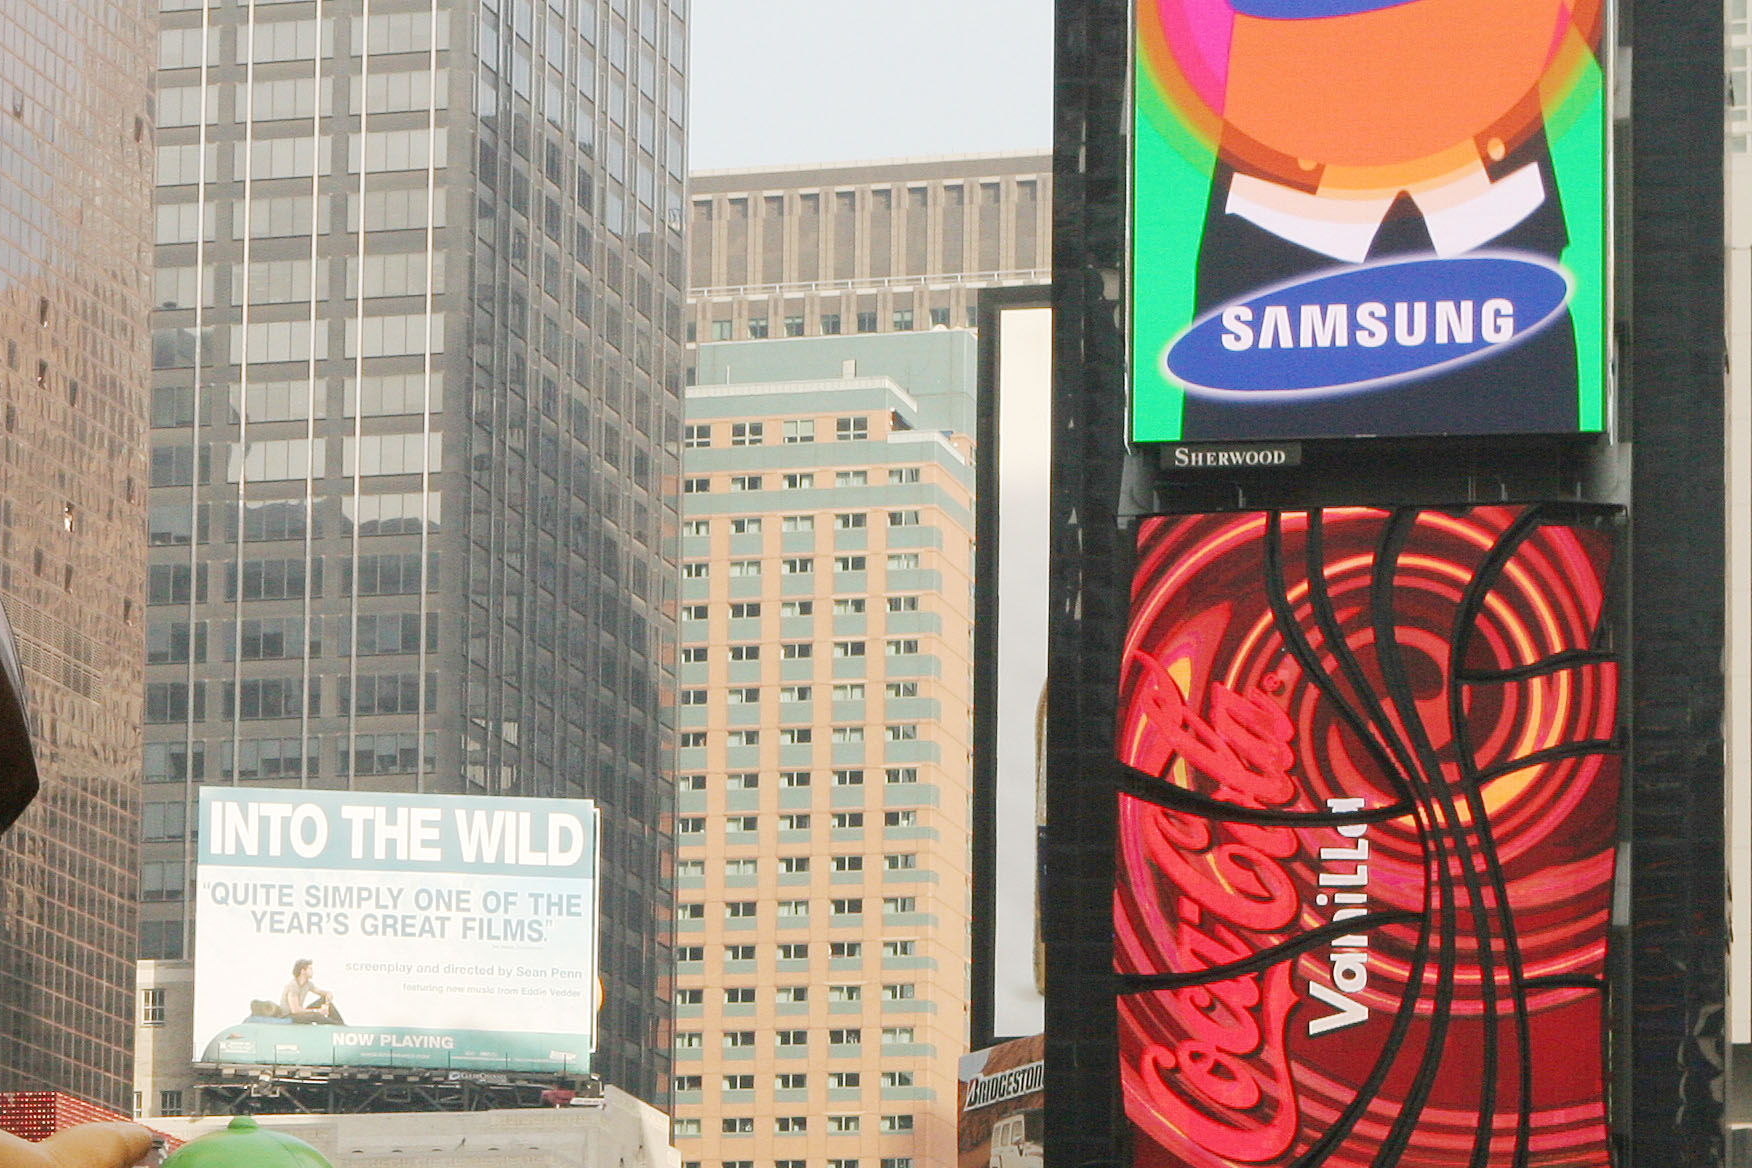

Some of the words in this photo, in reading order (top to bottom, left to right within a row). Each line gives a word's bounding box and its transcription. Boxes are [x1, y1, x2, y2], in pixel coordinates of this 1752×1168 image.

[1221, 299, 1515, 351] SAMSUNG
[1174, 446, 1286, 467] SHERWOOD
[209, 801, 329, 858] INTO
[342, 806, 442, 861] THE
[454, 808, 585, 867] WILD
[305, 884, 404, 911] SIMPLY
[413, 887, 472, 913] ONE
[482, 890, 517, 915] OF
[527, 892, 583, 917] THE
[1132, 650, 1301, 1163] Coca-Cola
[251, 911, 350, 936] YEAR'S
[360, 914, 452, 939] GREAT
[345, 961, 413, 975] screenplay
[416, 964, 440, 974] and
[443, 964, 494, 976] directed
[497, 965, 514, 978] by
[516, 966, 547, 978] Sean
[551, 967, 582, 979] Penn
[332, 1032, 376, 1048] NOW
[380, 1034, 454, 1050] PLAYING
